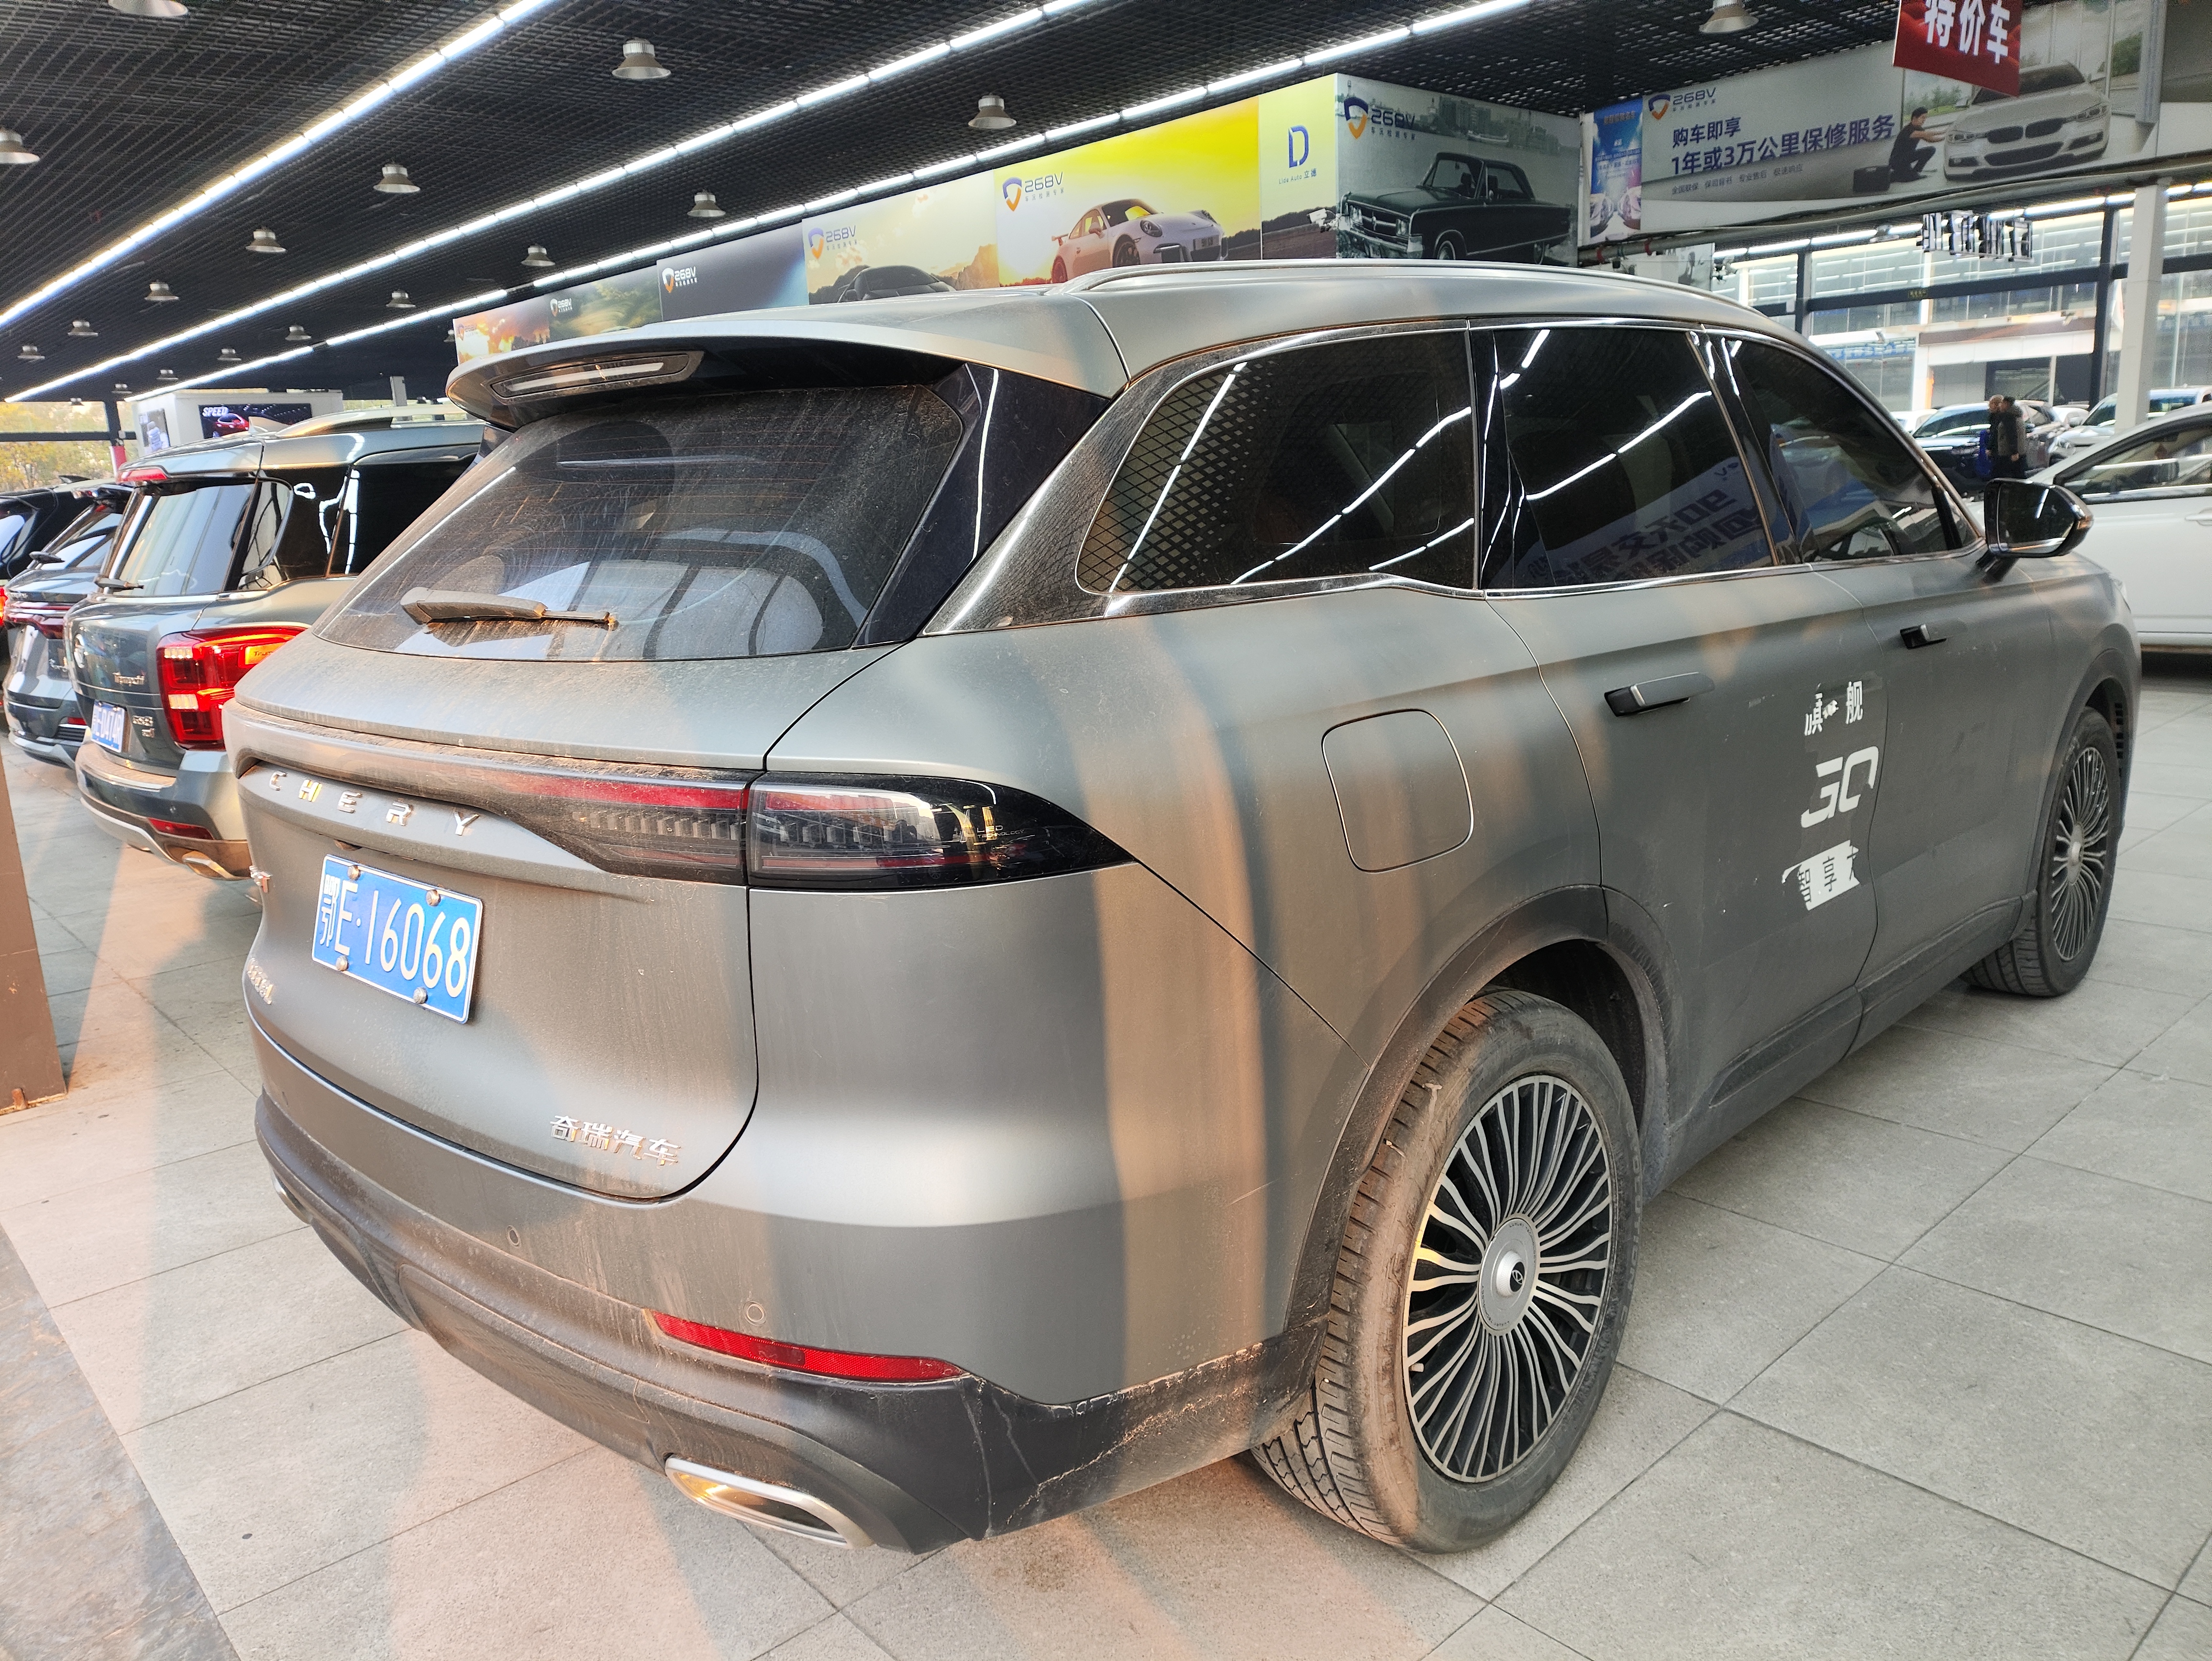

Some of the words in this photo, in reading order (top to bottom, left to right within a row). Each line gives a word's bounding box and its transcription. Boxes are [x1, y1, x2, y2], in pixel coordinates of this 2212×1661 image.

[1924, 0, 2010, 64] 特价车
[1672, 87, 1716, 105] 268V
[1371, 108, 1416, 129] 268V
[1672, 117, 1742, 149] 购车即享
[1672, 113, 1895, 175] 1年或3万公里保修服务
[1025, 171, 1063, 193] 268V
[826, 224, 856, 243] 268V
[674, 266, 696, 282] 268V
[557, 298, 572, 309] 268V
[202, 406, 229, 417] SPEED
[269, 770, 479, 836] CHERY
[977, 830, 1025, 838] TECHNOLOGY
[550, 1115, 682, 1166] 奇瑞汽车
